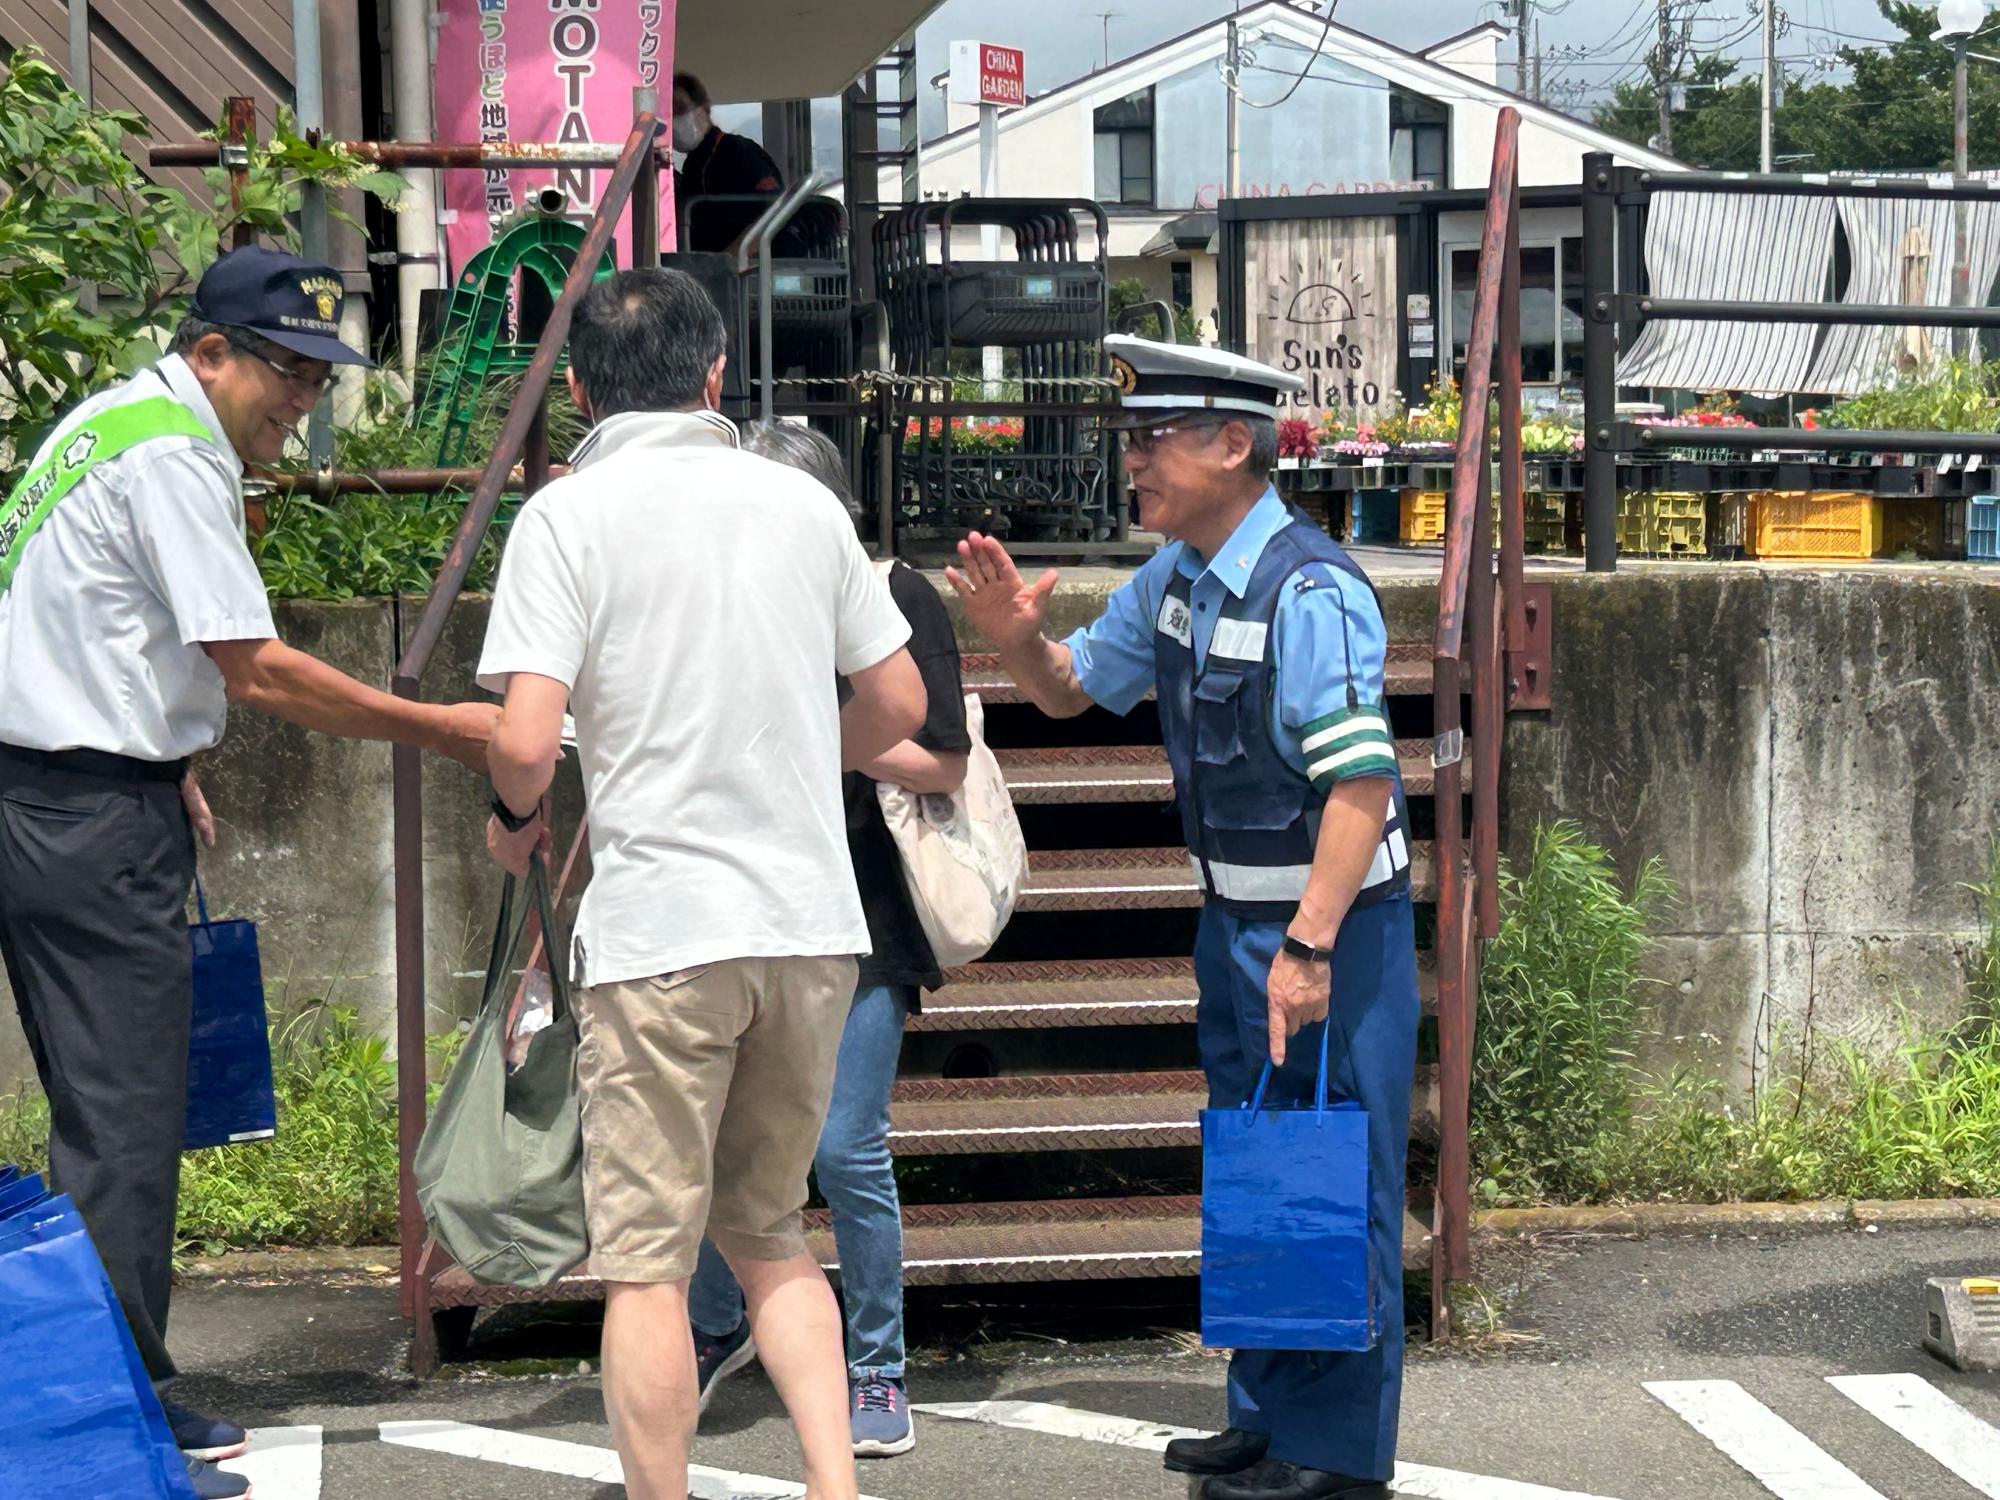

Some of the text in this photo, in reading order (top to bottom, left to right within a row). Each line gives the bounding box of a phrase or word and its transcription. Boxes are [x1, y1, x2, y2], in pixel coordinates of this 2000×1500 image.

[987, 49, 1018, 75] CHINA
[982, 74, 1022, 101] GARDEN
[480, 0, 513, 234] うほど地が元
[552, 0, 597, 230] OTAN
[1282, 334, 1363, 372] Sun's
